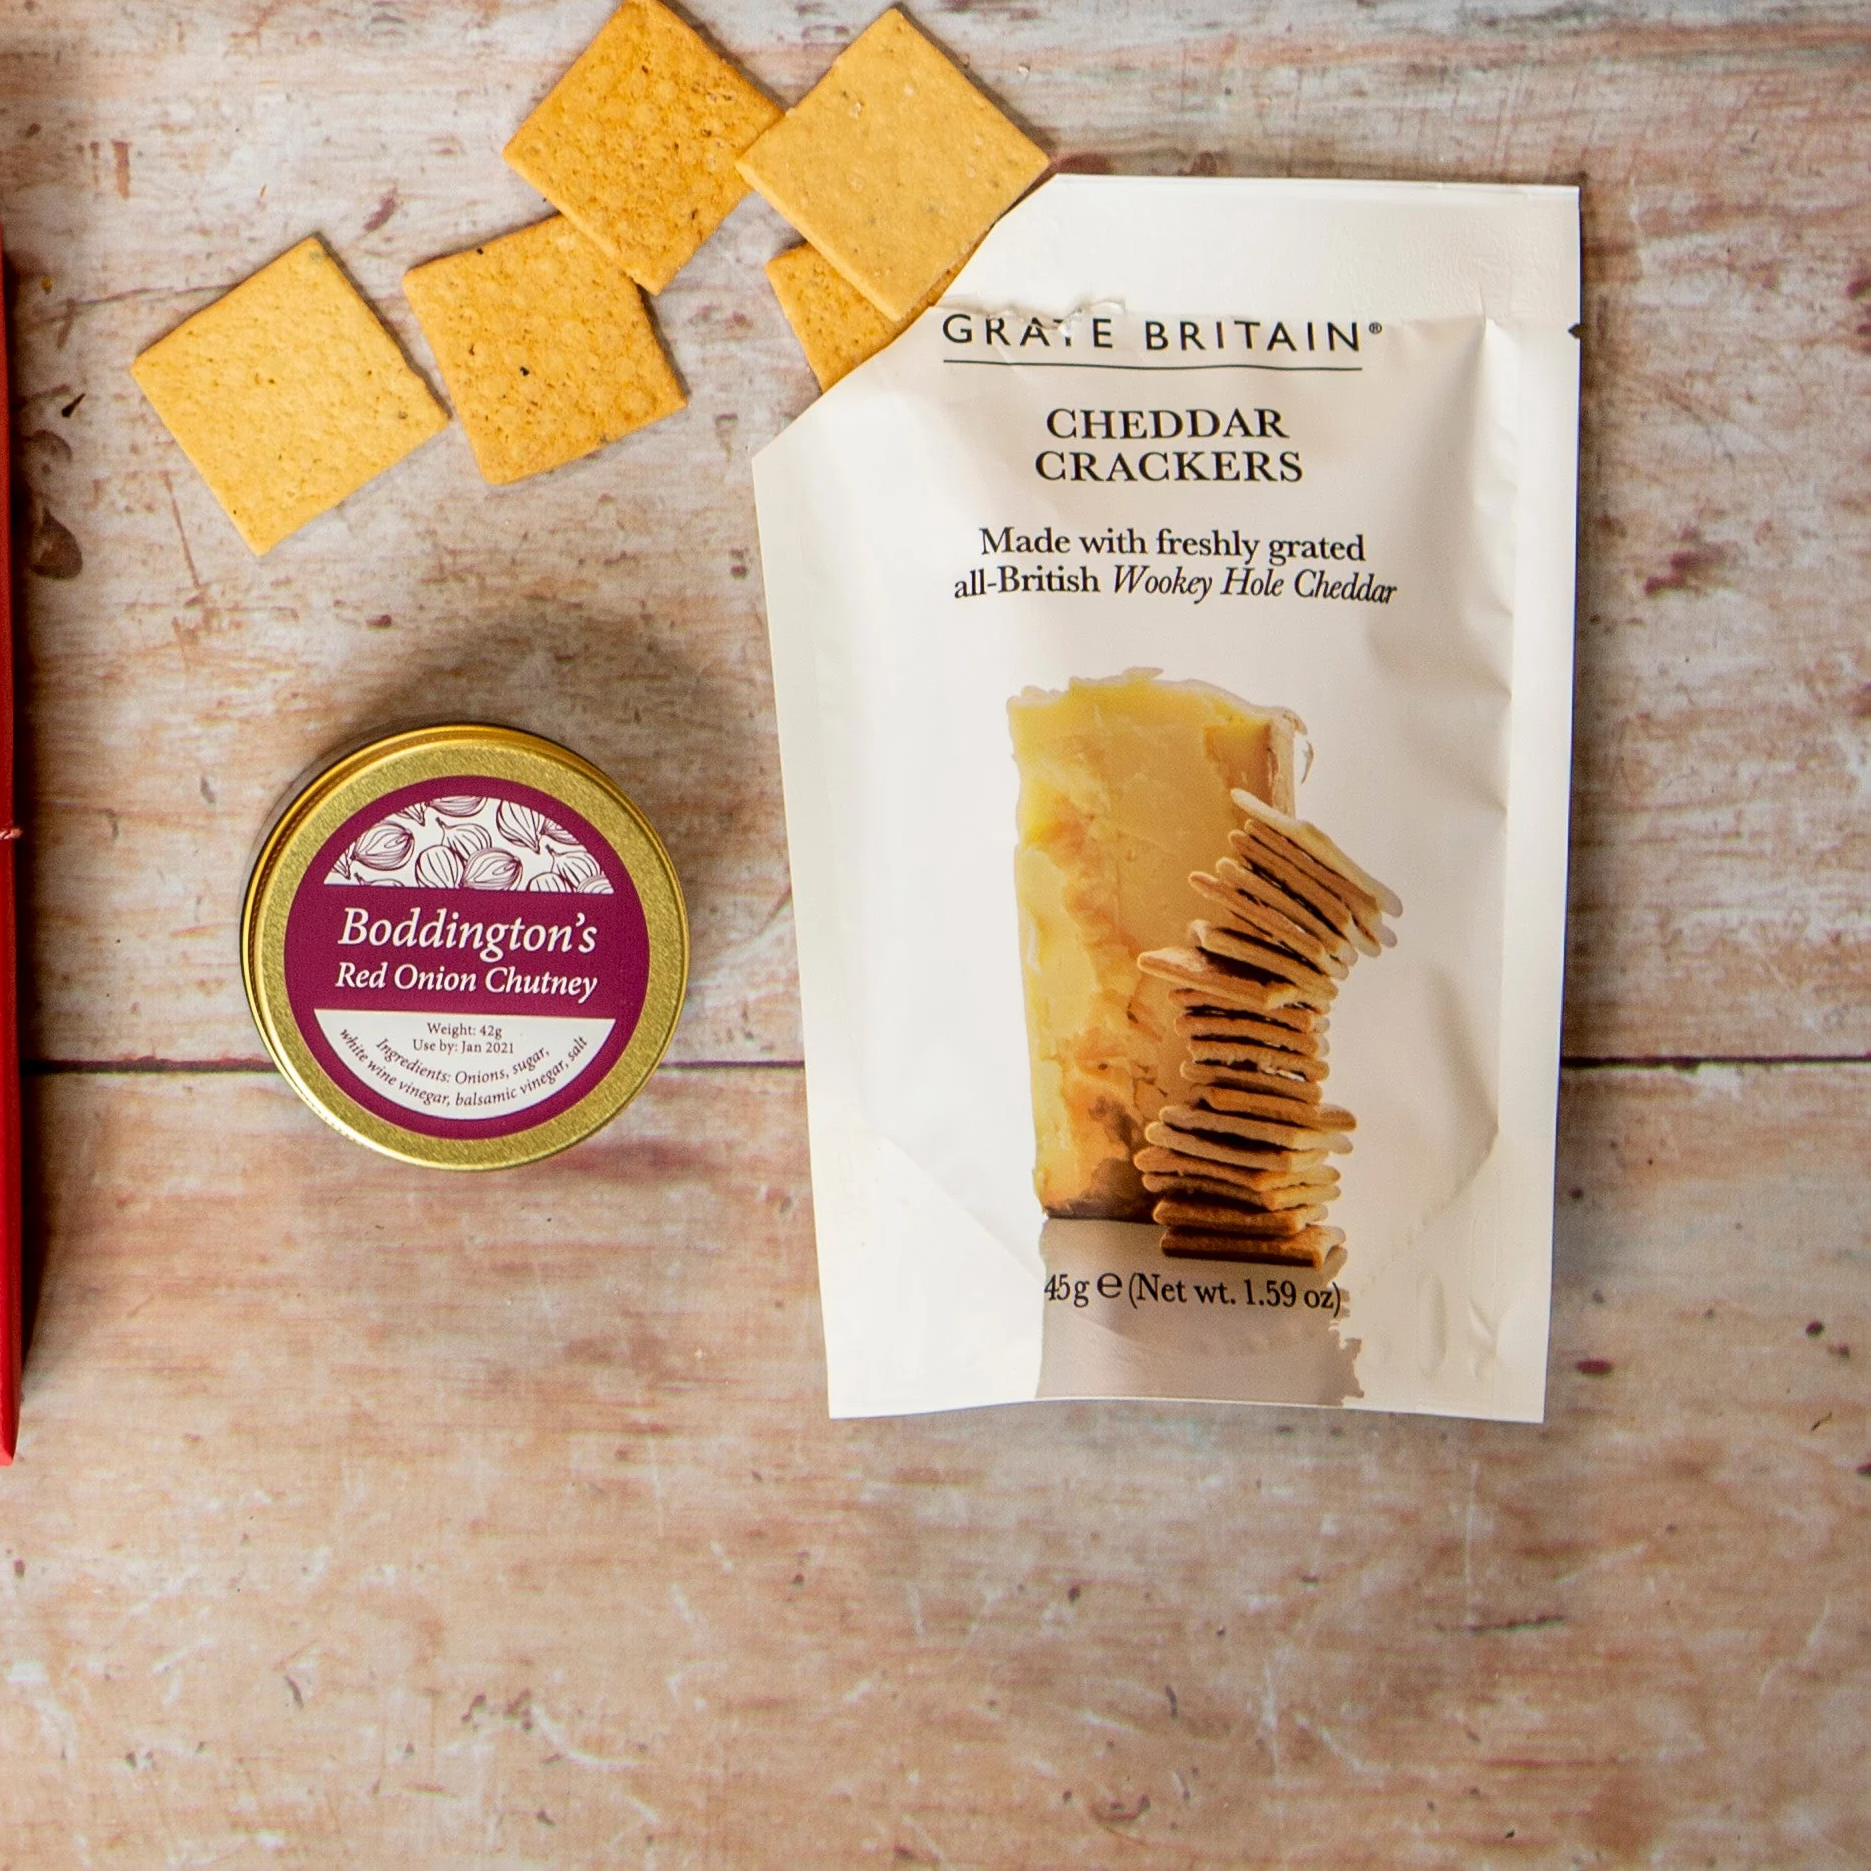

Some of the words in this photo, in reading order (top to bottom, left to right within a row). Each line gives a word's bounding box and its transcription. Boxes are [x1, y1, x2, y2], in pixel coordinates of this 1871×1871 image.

[1046, 407, 1290, 439] CHEDDAR
[1034, 450, 1303, 482] CRACKERS
[980, 527, 1071, 555] Made
[1079, 526, 1148, 555] with
[1156, 529, 1259, 563] freshly
[1269, 533, 1366, 566] grated
[954, 565, 1100, 599] all-British
[1113, 564, 1213, 604] Wookey
[1220, 566, 1284, 598] Hole
[1294, 568, 1398, 605] Cheddar
[337, 906, 598, 964] Boddington's
[334, 961, 389, 990] Red
[394, 963, 477, 993] Onion
[485, 965, 599, 1004] Chutney
[412, 1039, 437, 1053] Use
[439, 1038, 458, 1055] by:
[460, 1040, 483, 1055] Jan
[486, 1041, 515, 1055] 2021
[426, 1021, 476, 1038] Weight:
[479, 1025, 503, 1040] 42g
[339, 1028, 369, 1063] white
[367, 1060, 397, 1086] wine
[398, 1079, 452, 1107] vinegar,
[455, 1086, 518, 1107] balsamic
[519, 1058, 569, 1095] vinegar,
[567, 1035, 589, 1062] salt
[375, 1037, 451, 1084] Ingredients:
[455, 1070, 510, 1086] Onions,
[512, 1047, 550, 1076] sugar,
[1044, 1273, 1090, 1307] 45g
[1129, 1272, 1186, 1310] (Net
[1194, 1283, 1237, 1306] wt.
[1246, 1279, 1297, 1307] 1.59
[1304, 1282, 1342, 1317] oz)
